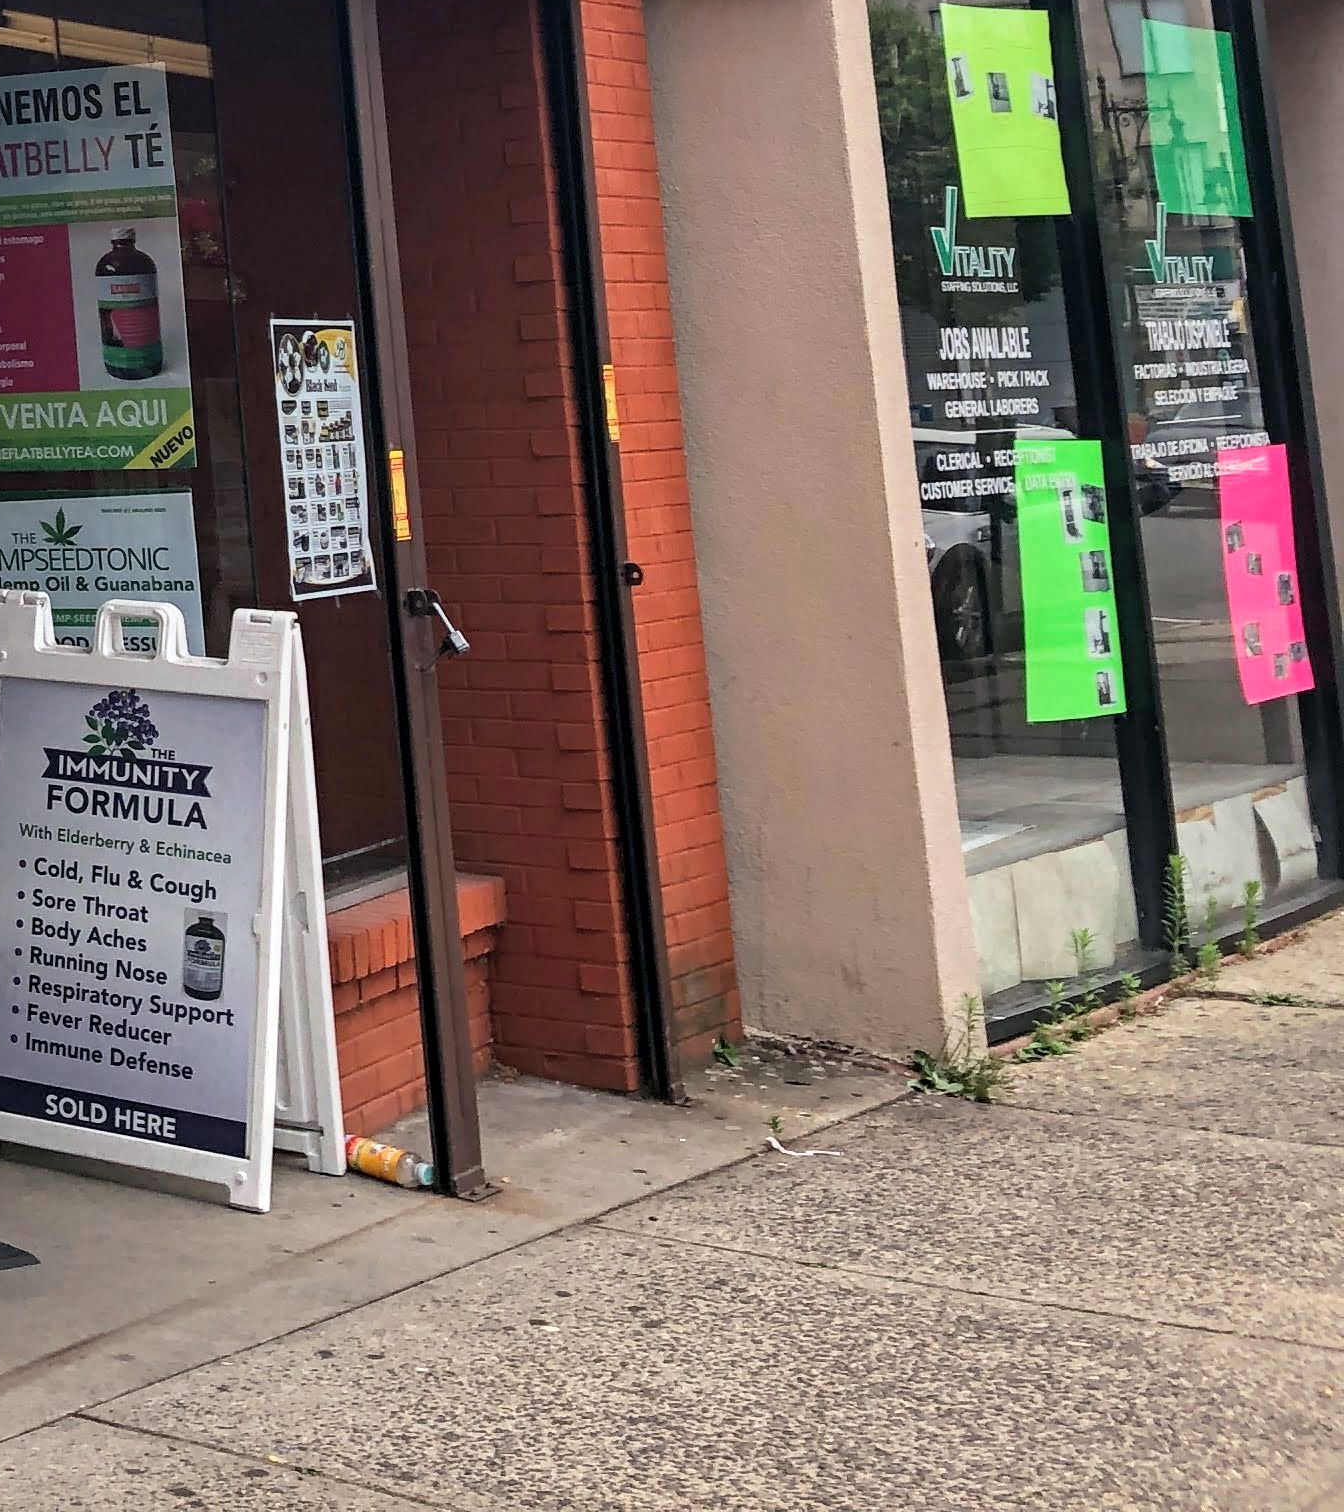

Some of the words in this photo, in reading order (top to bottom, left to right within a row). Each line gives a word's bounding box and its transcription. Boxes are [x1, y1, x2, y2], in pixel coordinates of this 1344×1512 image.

[113, 81, 151, 117] EL
[125, 123, 164, 169] TÉ
[930, 186, 1016, 278] VITALITY
[1144, 202, 1214, 284] VITALITY
[939, 326, 970, 360] JOBS
[971, 327, 1032, 360] AVAILABLE
[927, 371, 987, 390] WAREHOUSE
[1133, 362, 1177, 379] FACTORIAS
[0, 401, 89, 430] VENTA
[96, 399, 168, 428] AQUI
[945, 400, 990, 419] GENERAL
[990, 398, 1039, 416] LABORERS
[149, 425, 194, 468] NUEVO
[936, 451, 984, 472] CLERICAL
[921, 480, 974, 501] CUSTOMER
[975, 476, 1013, 497] SERVICE
[12, 532, 36, 544] THE
[46, 576, 70, 592] Oil
[76, 577, 90, 592] &
[94, 575, 195, 592] Guanabana
[151, 748, 175, 761] THE
[59, 755, 200, 790] IMMUNITY
[47, 784, 207, 830] FORMULA
[19, 823, 52, 841] With
[57, 828, 135, 855] Elderberry
[139, 839, 151, 854] &
[156, 841, 232, 865] Echinacea
[34, 857, 83, 884] Cold,
[91, 864, 121, 887] Flu
[127, 870, 143, 889] &
[150, 873, 217, 903] Cough
[32, 889, 76, 912] Sore
[83, 895, 149, 923] Throat
[31, 917, 81, 946] Body
[87, 926, 147, 952] Aches
[29, 945, 108, 981] Running
[116, 959, 168, 985] Nose
[28, 974, 143, 1016] Respiratory
[149, 995, 235, 1027] Support
[27, 1003, 83, 1030] Fever
[88, 1013, 172, 1046] Reducer
[25, 1032, 103, 1063] Immune
[110, 1047, 194, 1080] Defense
[45, 1094, 107, 1124] SOLD
[114, 1107, 177, 1139] HERE
